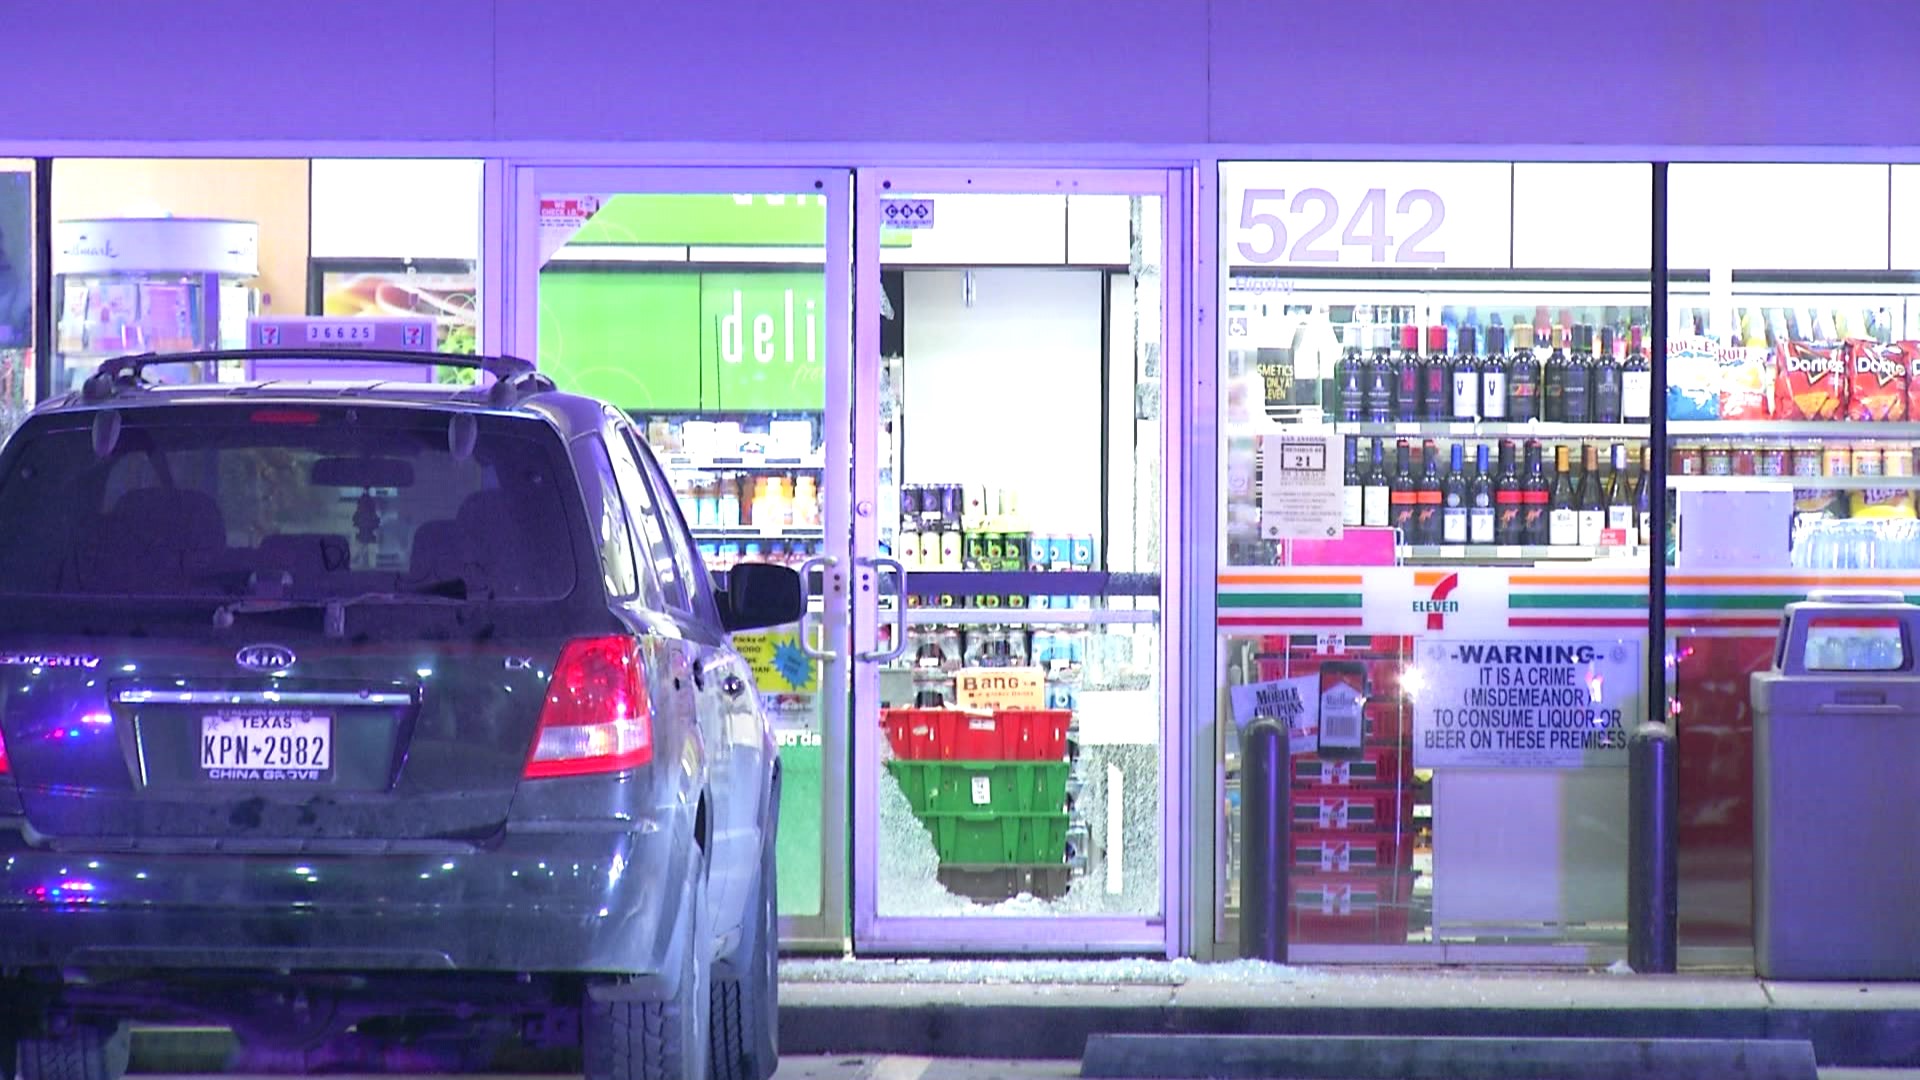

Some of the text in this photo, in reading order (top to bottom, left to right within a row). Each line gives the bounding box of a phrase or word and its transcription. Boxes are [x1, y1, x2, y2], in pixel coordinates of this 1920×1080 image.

[1236, 187, 1446, 264] 5242
[311, 327, 370, 338] 36625
[722, 289, 816, 363] deli
[1257, 364, 1294, 377] SMETICS
[1857, 357, 1906, 377] Dorito
[1264, 388, 1286, 400] EVEN
[1295, 455, 1311, 468] 21
[1413, 571, 1459, 630] 7
[246, 649, 285, 666] KIA
[1479, 667, 1576, 686] IT IS A CRIME
[1255, 686, 1299, 705] MOBILE
[240, 717, 293, 729] TEXAS
[1433, 708, 1622, 728] TO CONSUME LIQUOR OR
[1424, 731, 1627, 749] BEER ON THESE PREMISES
[203, 735, 324, 766] KPN 2982
[208, 769, 260, 780] CHINA
